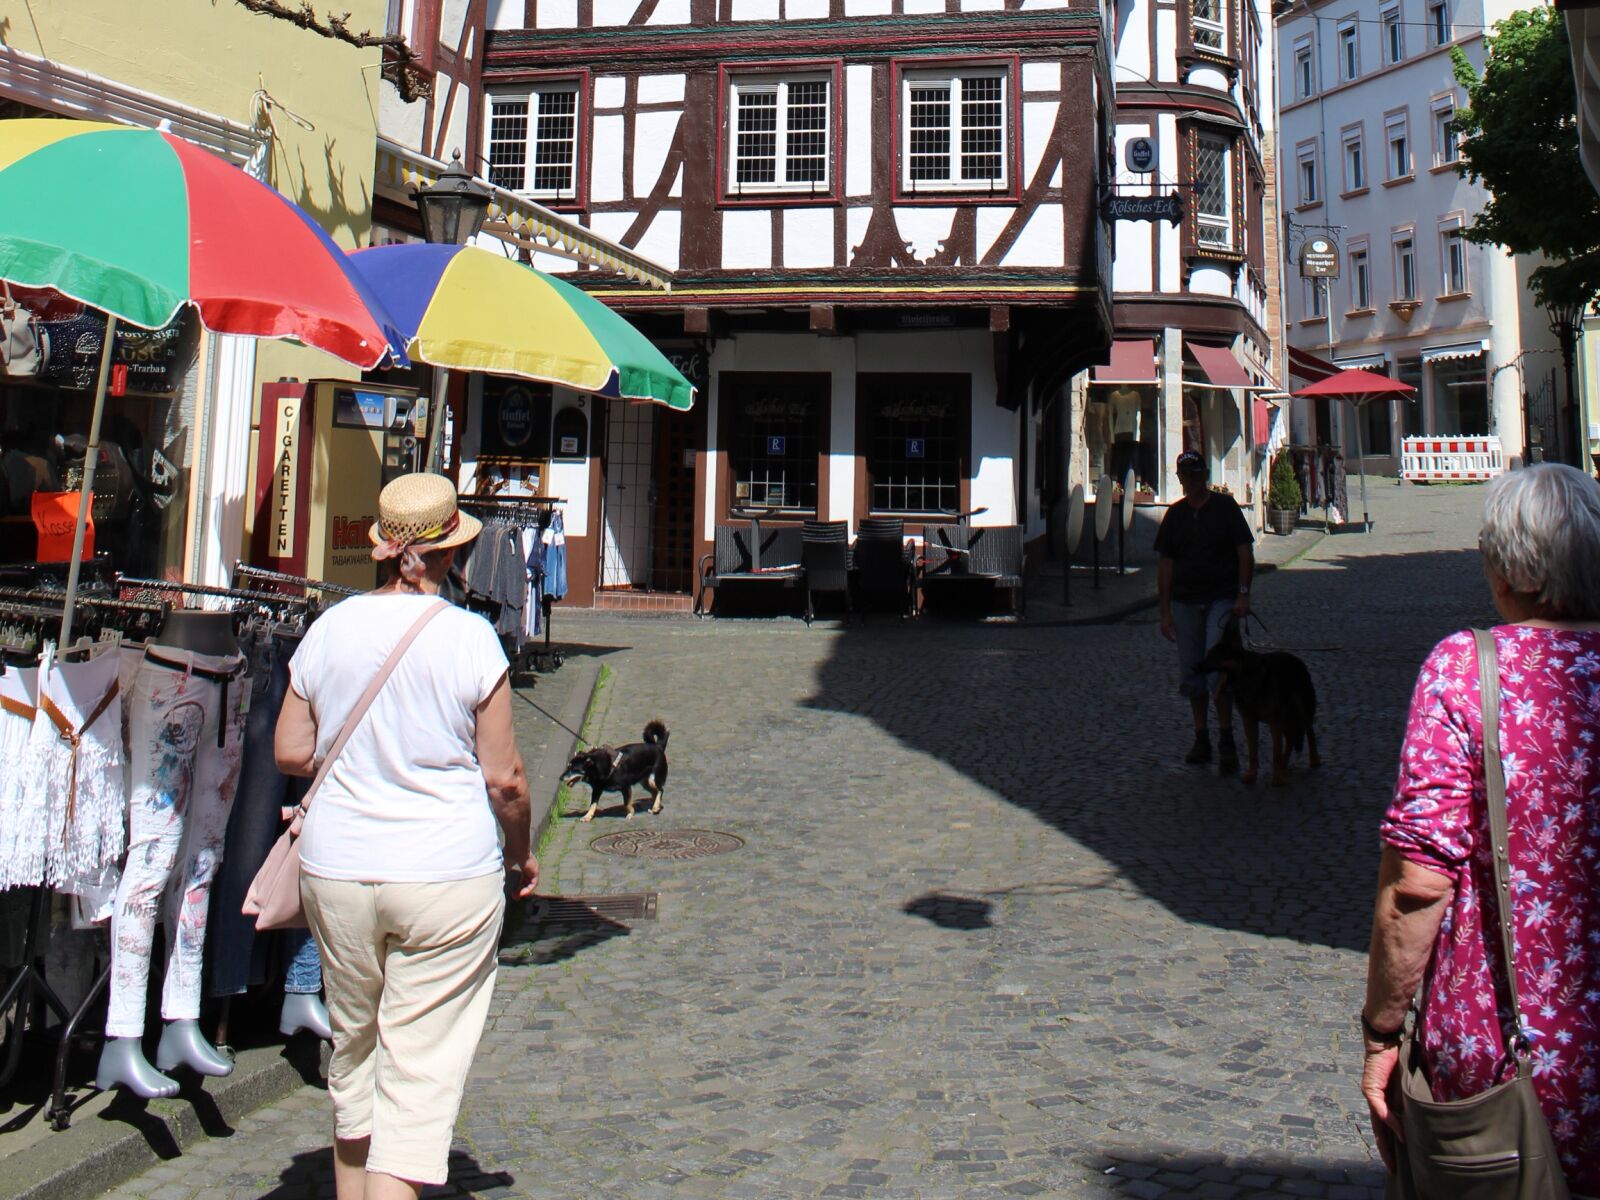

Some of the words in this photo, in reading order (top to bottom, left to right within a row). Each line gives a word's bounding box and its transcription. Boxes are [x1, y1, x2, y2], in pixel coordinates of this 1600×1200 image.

[1109, 200, 1152, 216] Kölsches
[1153, 200, 1176, 214] Eck
[577, 396, 585, 407] 5
[277, 406, 293, 551] CIGARETTEN
[332, 554, 372, 566] TABAKWAREN
